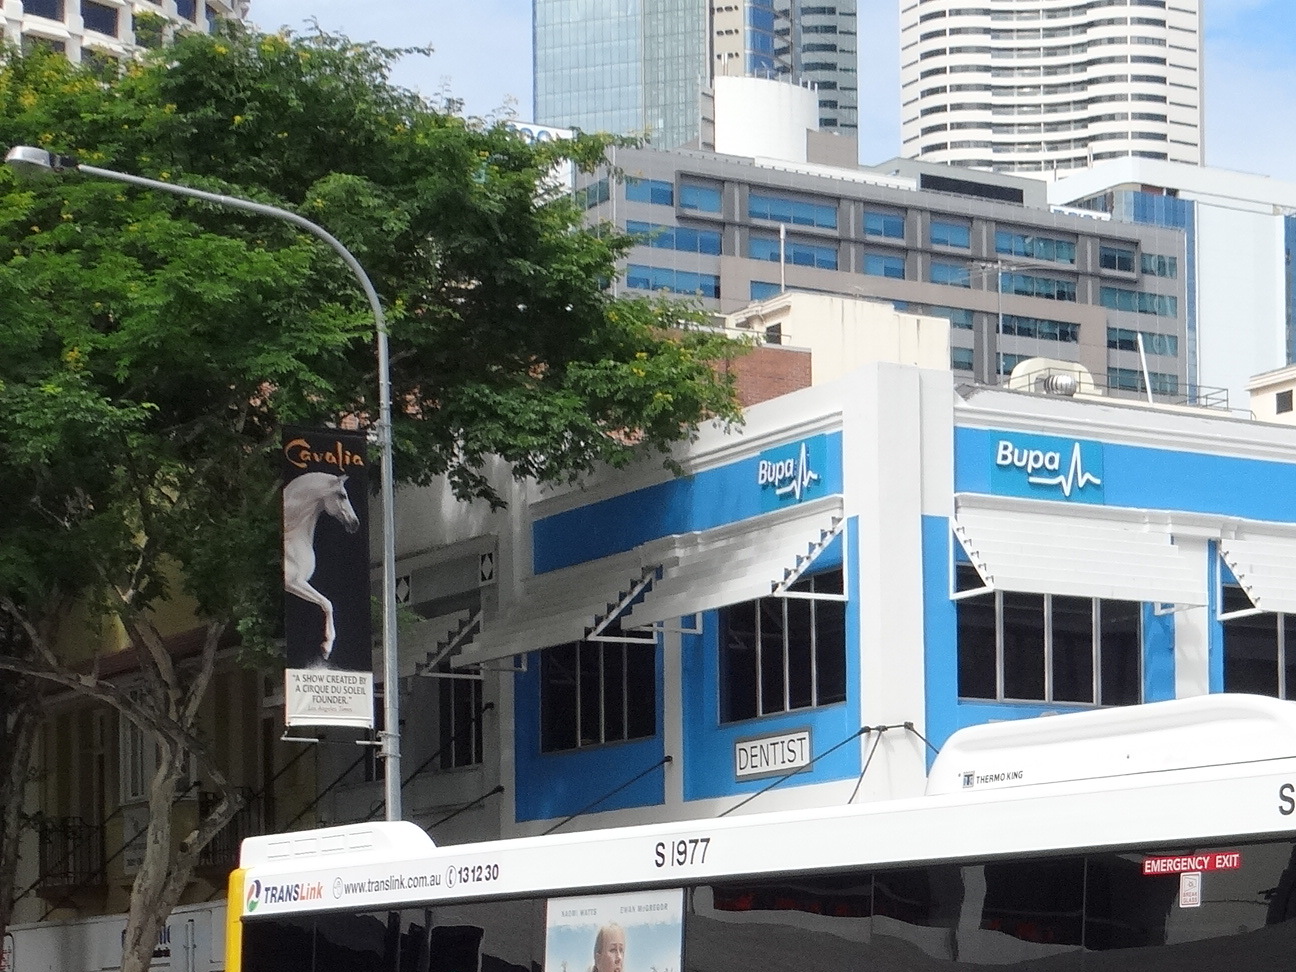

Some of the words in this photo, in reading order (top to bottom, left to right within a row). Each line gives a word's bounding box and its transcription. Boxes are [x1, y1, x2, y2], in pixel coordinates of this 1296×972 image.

[284, 437, 364, 472] Cavalia
[997, 440, 1060, 470] Bupa
[758, 458, 792, 486] Bupa
[295, 684, 301, 693] A
[303, 684, 329, 695] CIRQUE
[331, 686, 342, 695] DU
[344, 686, 366, 696] SOLEIL
[303, 674, 325, 684] SHOW
[326, 675, 358, 685] CREATED
[359, 676, 367, 685] BY
[738, 737, 807, 770] DENTIST
[976, 773, 1005, 784] THERMO
[1007, 770, 1023, 780] KING
[1278, 783, 1295, 815] S
[655, 842, 665, 867] S
[671, 837, 711, 866] 1977
[1144, 856, 1210, 873] EMERGENCY
[1216, 853, 1239, 867] EXIT
[264, 881, 324, 904] TRANSLink
[344, 873, 441, 895] www.translink.com.au
